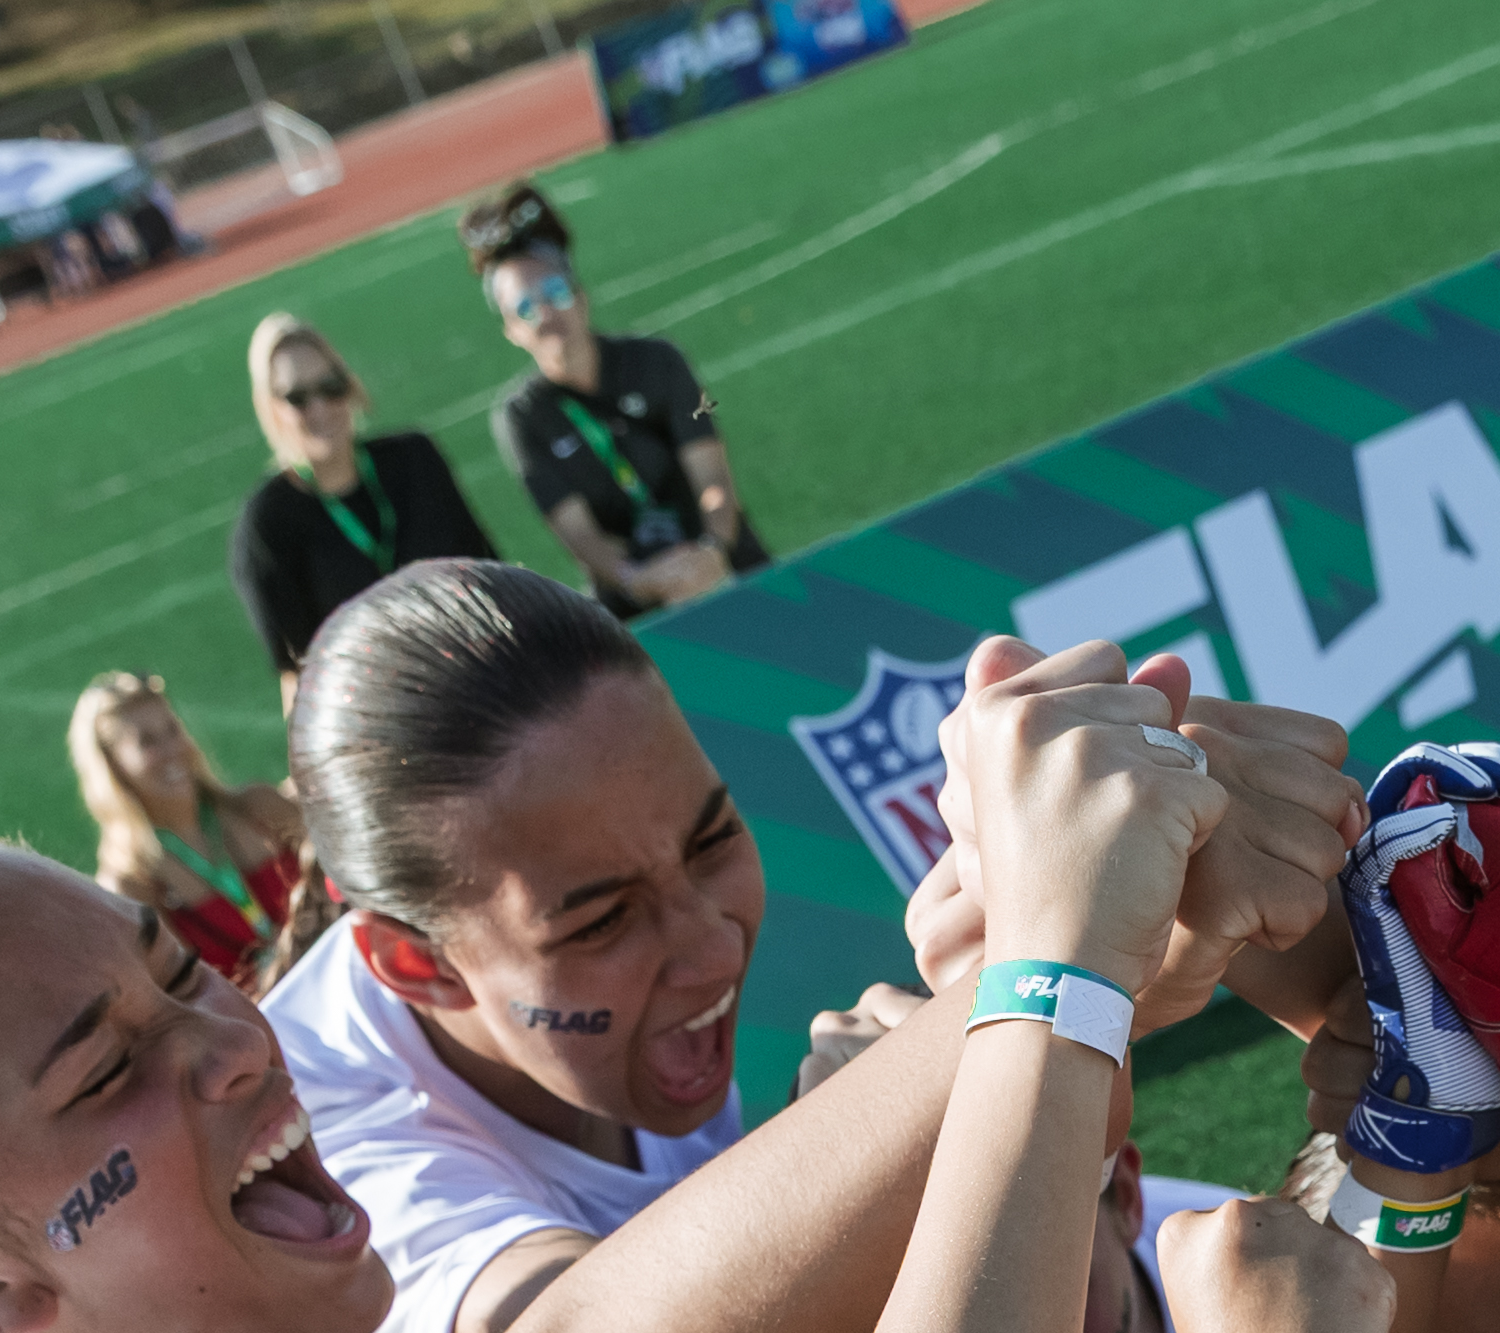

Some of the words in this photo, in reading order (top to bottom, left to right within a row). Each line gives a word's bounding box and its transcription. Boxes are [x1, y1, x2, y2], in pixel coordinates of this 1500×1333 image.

[1021, 974, 1063, 999] FL
[528, 1008, 612, 1035] FLAG
[60, 1148, 139, 1246] FLAG
[1403, 1211, 1454, 1238] FLAG
